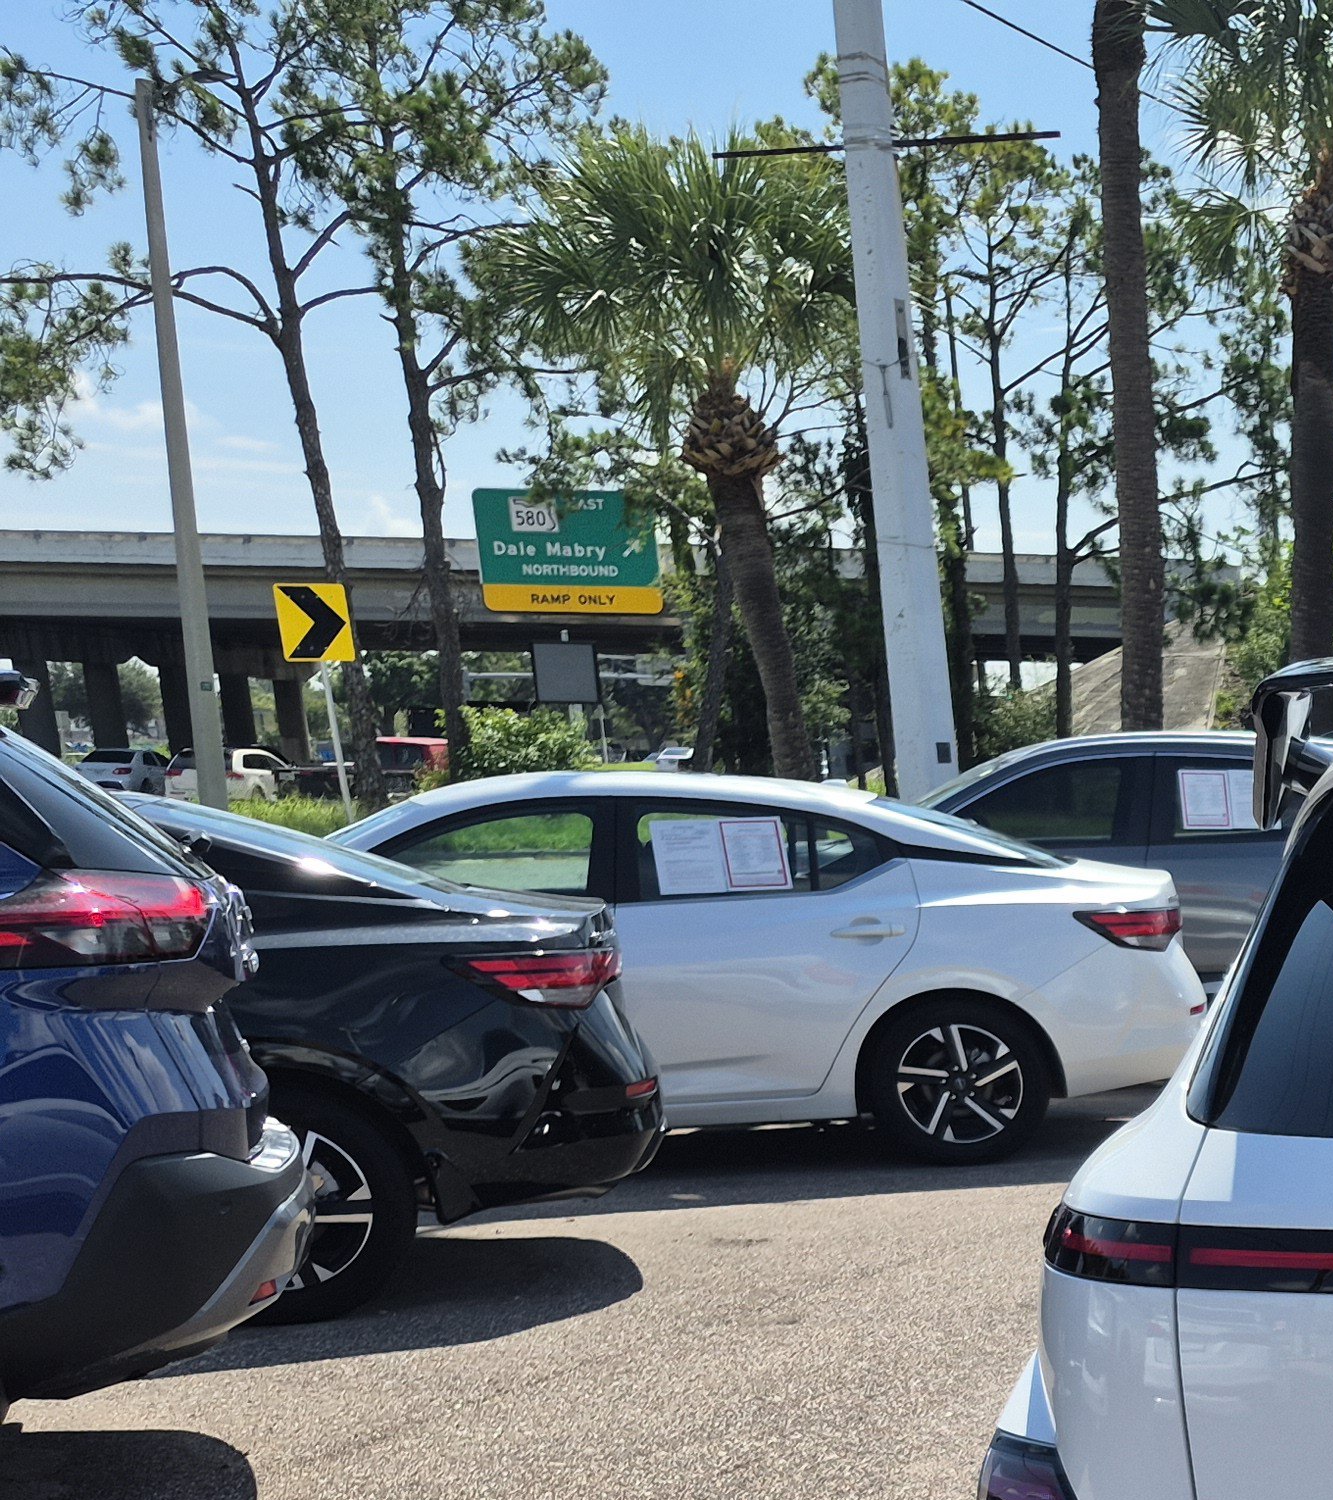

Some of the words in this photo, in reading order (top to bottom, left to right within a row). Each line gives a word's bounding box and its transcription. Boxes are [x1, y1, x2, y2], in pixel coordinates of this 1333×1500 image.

[570, 498, 605, 510] AST
[515, 510, 546, 527] 580
[493, 540, 536, 556] Dale
[545, 541, 606, 561] Mabry
[521, 563, 619, 577] NORTHBOUND
[531, 593, 571, 605] RAMP
[578, 594, 616, 605] ONLY
